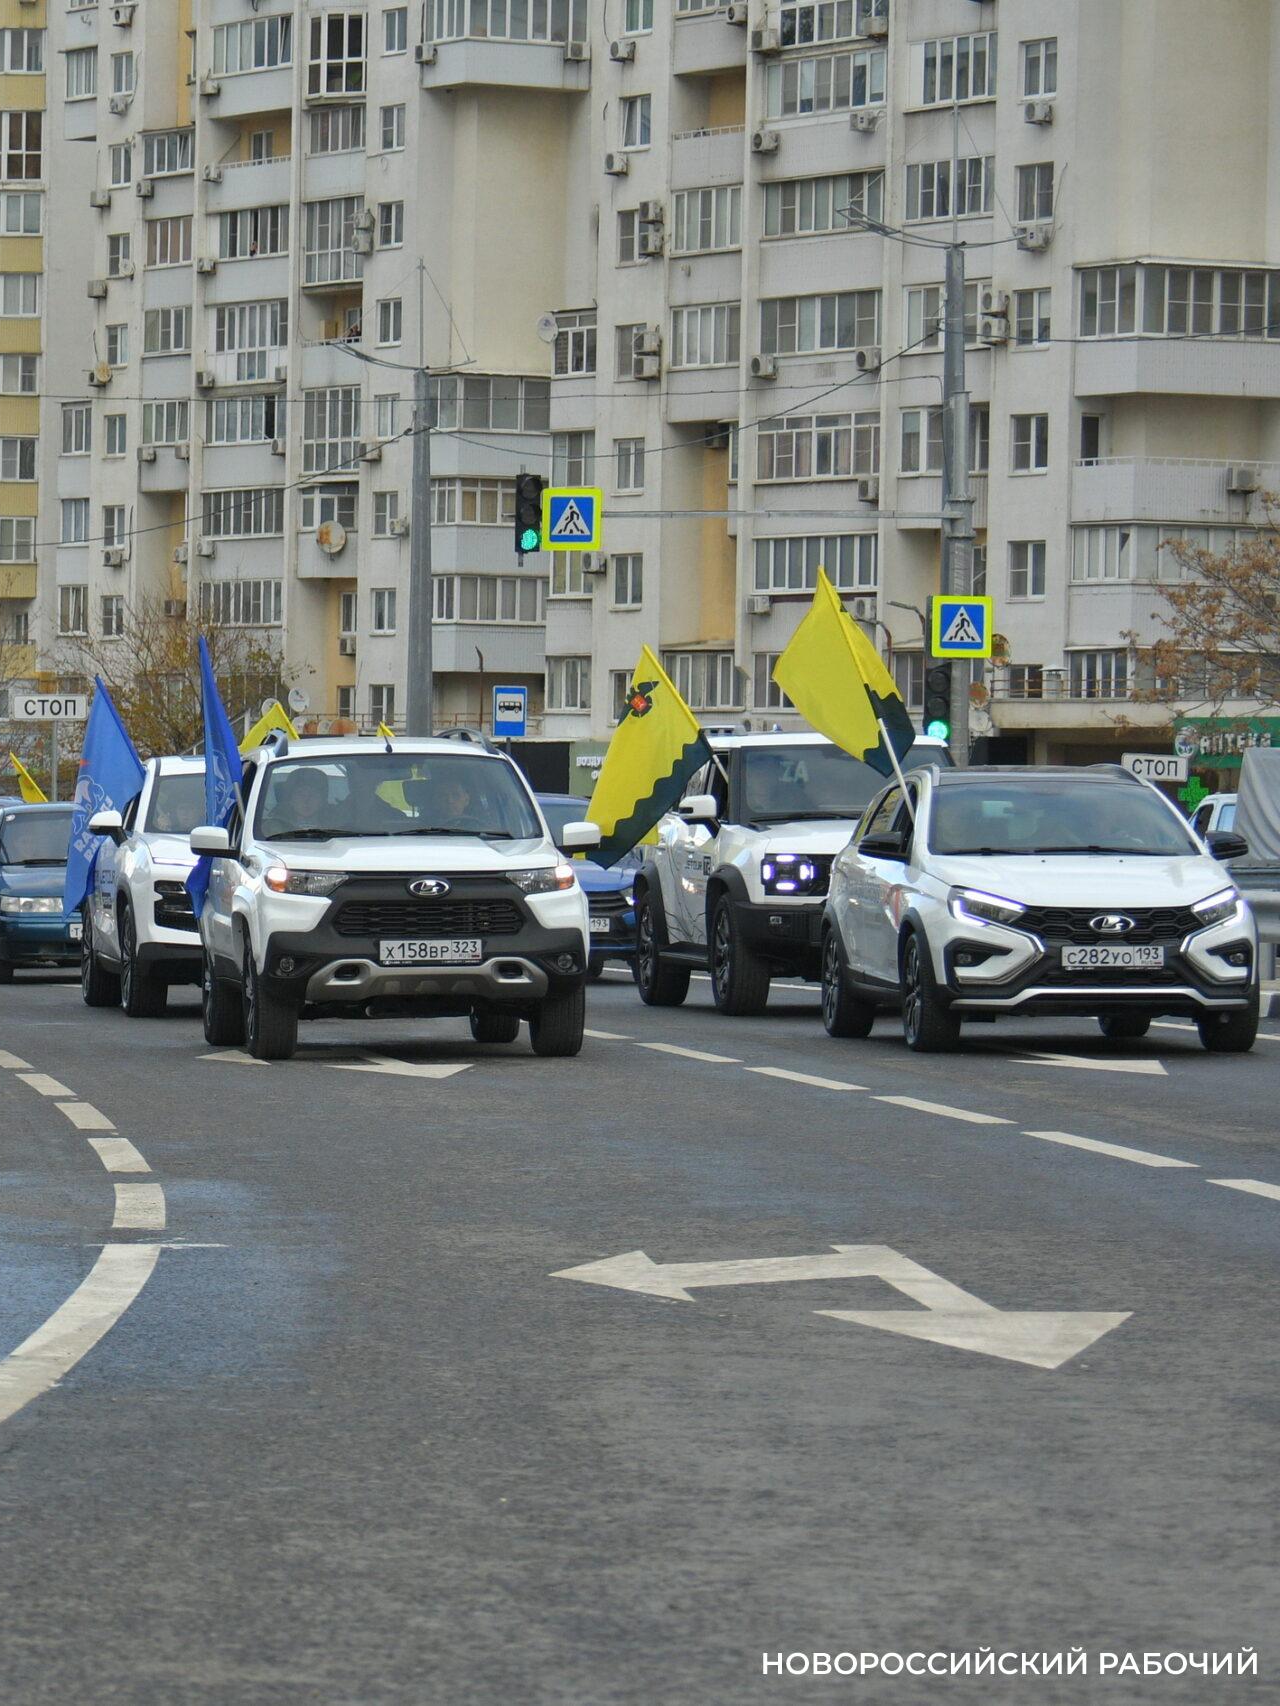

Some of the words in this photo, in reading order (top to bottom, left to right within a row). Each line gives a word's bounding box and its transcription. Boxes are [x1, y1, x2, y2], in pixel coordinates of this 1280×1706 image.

[24, 699, 76, 716] СТОП
[576, 756, 603, 767] ВОЗДУ
[1132, 758, 1178, 777] СТОП
[591, 919, 607, 928] 193
[385, 942, 449, 958] Х158ВР
[452, 941, 477, 953] 323
[1067, 948, 1132, 964] С282УО
[1135, 947, 1159, 959] 193
